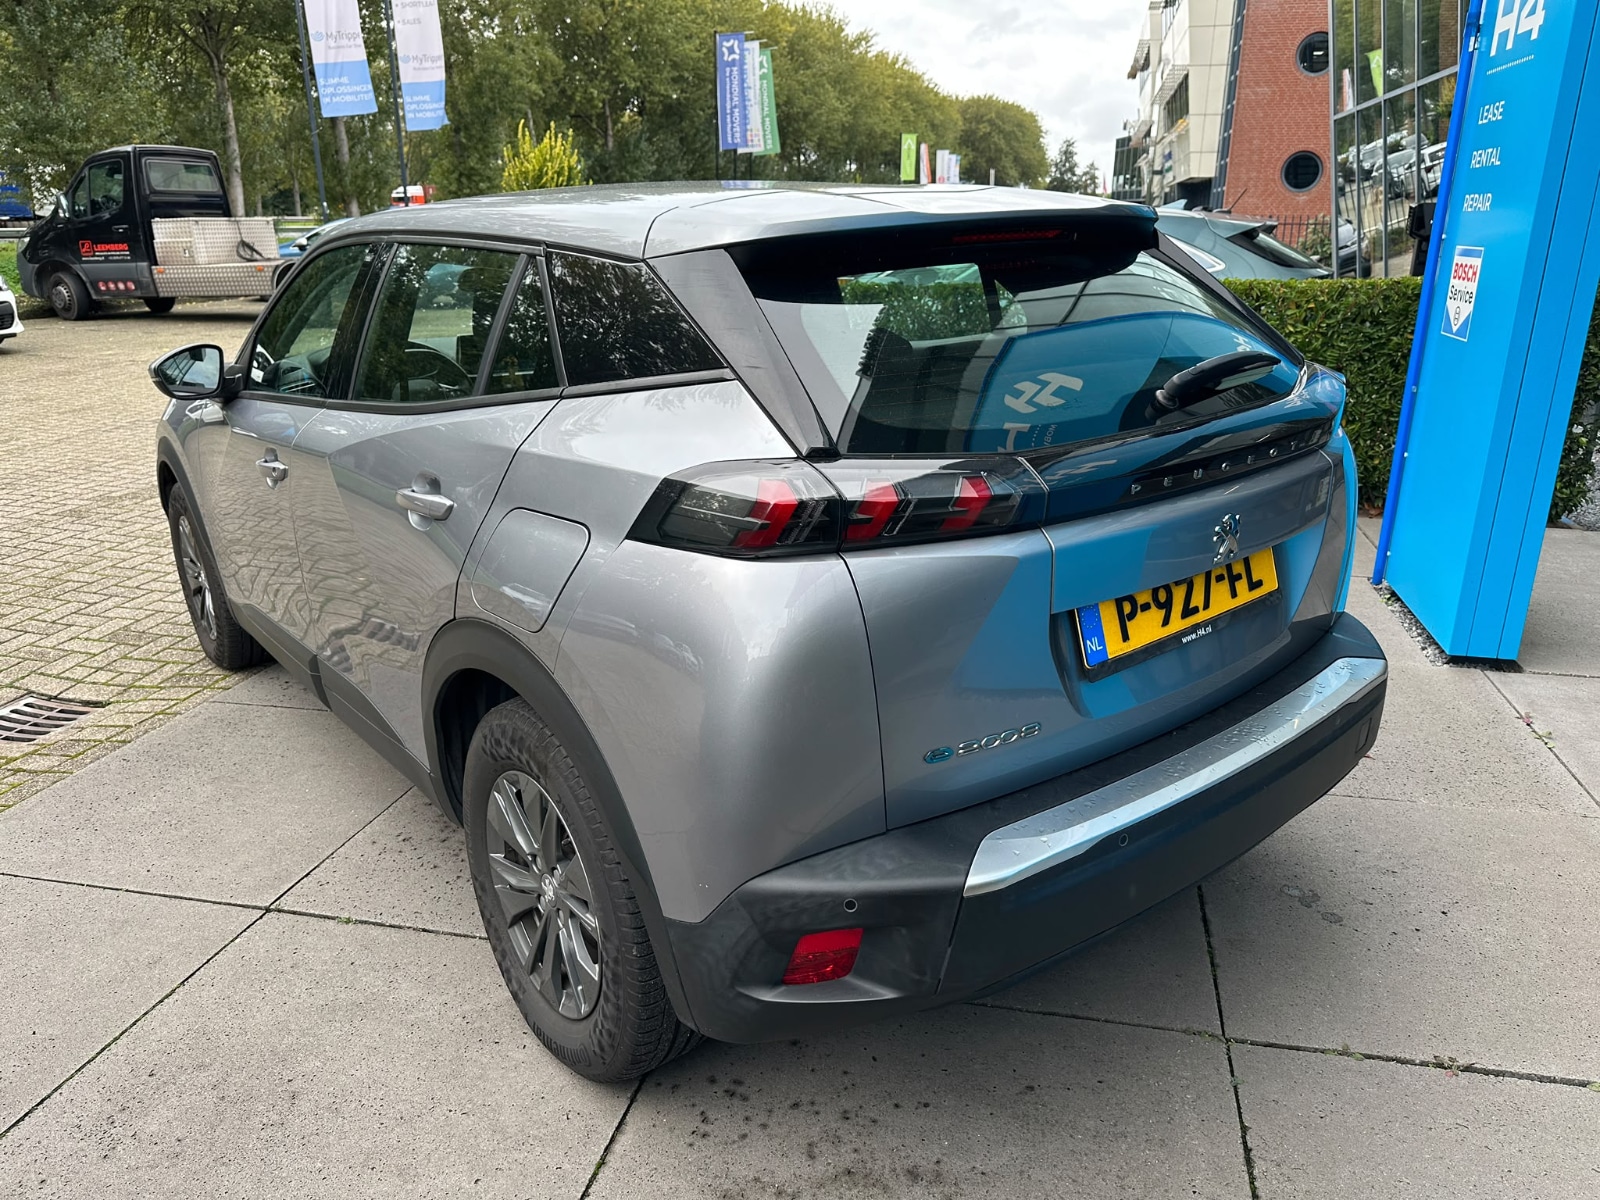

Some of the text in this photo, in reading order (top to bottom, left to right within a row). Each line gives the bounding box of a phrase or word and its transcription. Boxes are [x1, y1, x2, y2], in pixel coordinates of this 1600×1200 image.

[1490, 0, 1546, 57] H4
[730, 66, 741, 144] MONDIAL MOVERS
[761, 80, 773, 150] MONDIAL MOVERS
[1478, 100, 1506, 125] LEASE
[1470, 146, 1501, 169] RENTAL
[1462, 193, 1493, 212] REPAIR
[93, 243, 129, 251] LEEMBERG
[1452, 262, 1478, 283] BOSCH
[1449, 285, 1474, 304] Service
[1130, 440, 1298, 495] PEUGEOT
[1085, 636, 1104, 654] NL
[1181, 624, 1213, 644] www.H4.nl
